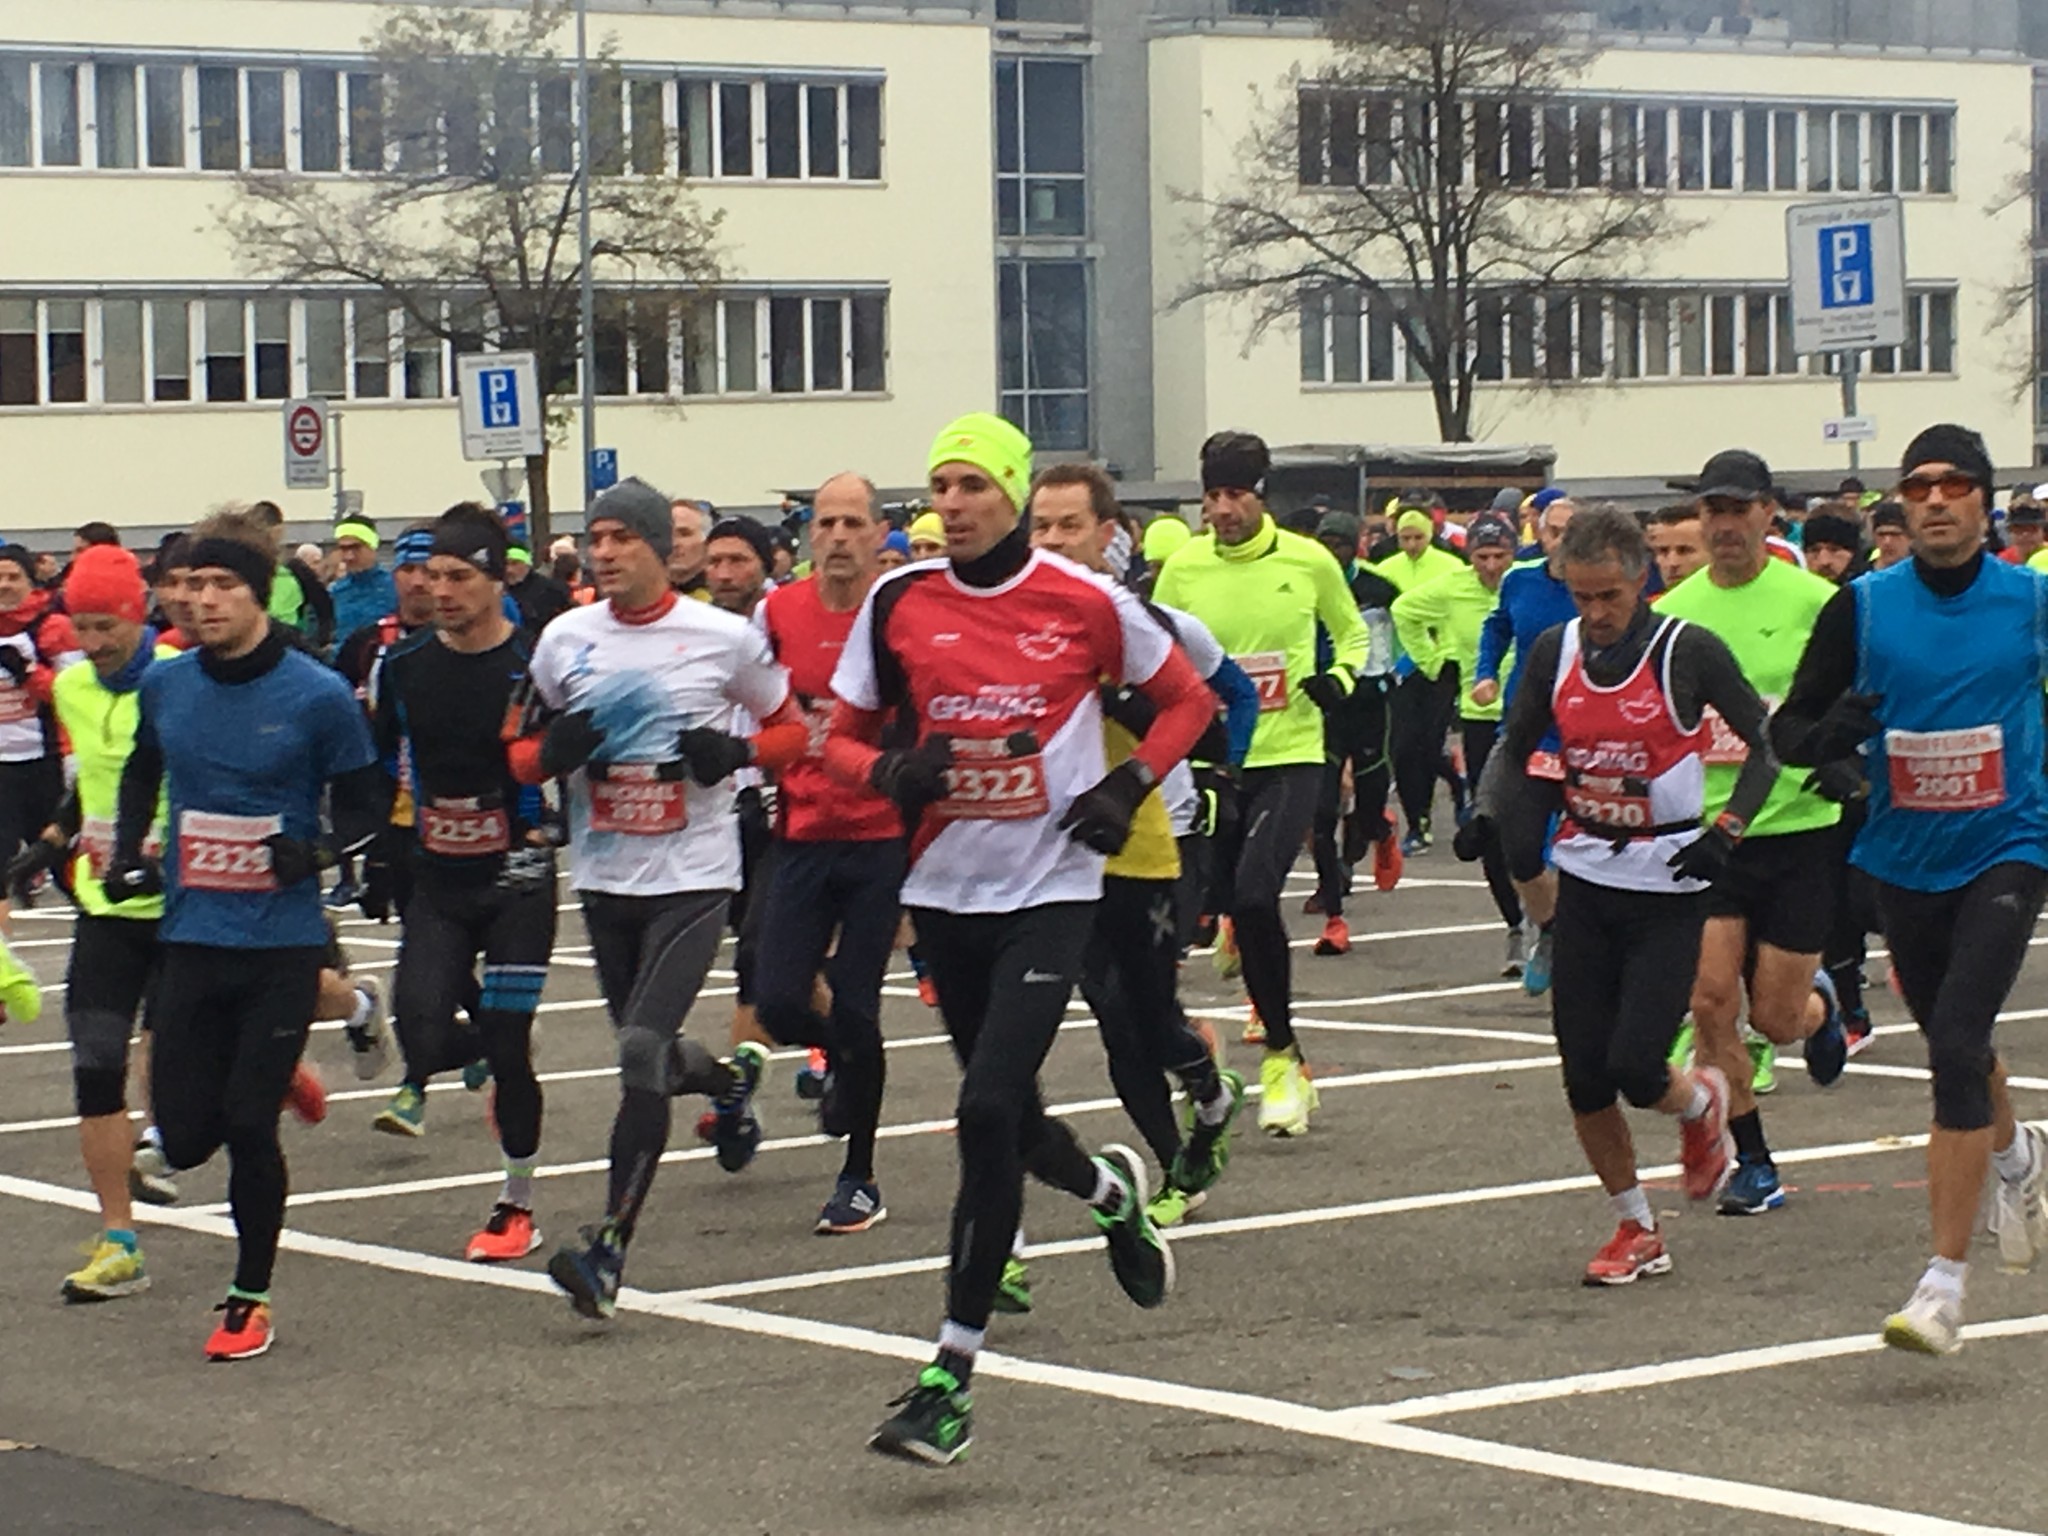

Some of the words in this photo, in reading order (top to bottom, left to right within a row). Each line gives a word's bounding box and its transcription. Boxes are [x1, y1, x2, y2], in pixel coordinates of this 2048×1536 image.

[1832, 231, 1857, 271] P
[489, 373, 508, 402] P
[1914, 773, 1977, 797] 2001
[425, 815, 503, 842] 2254
